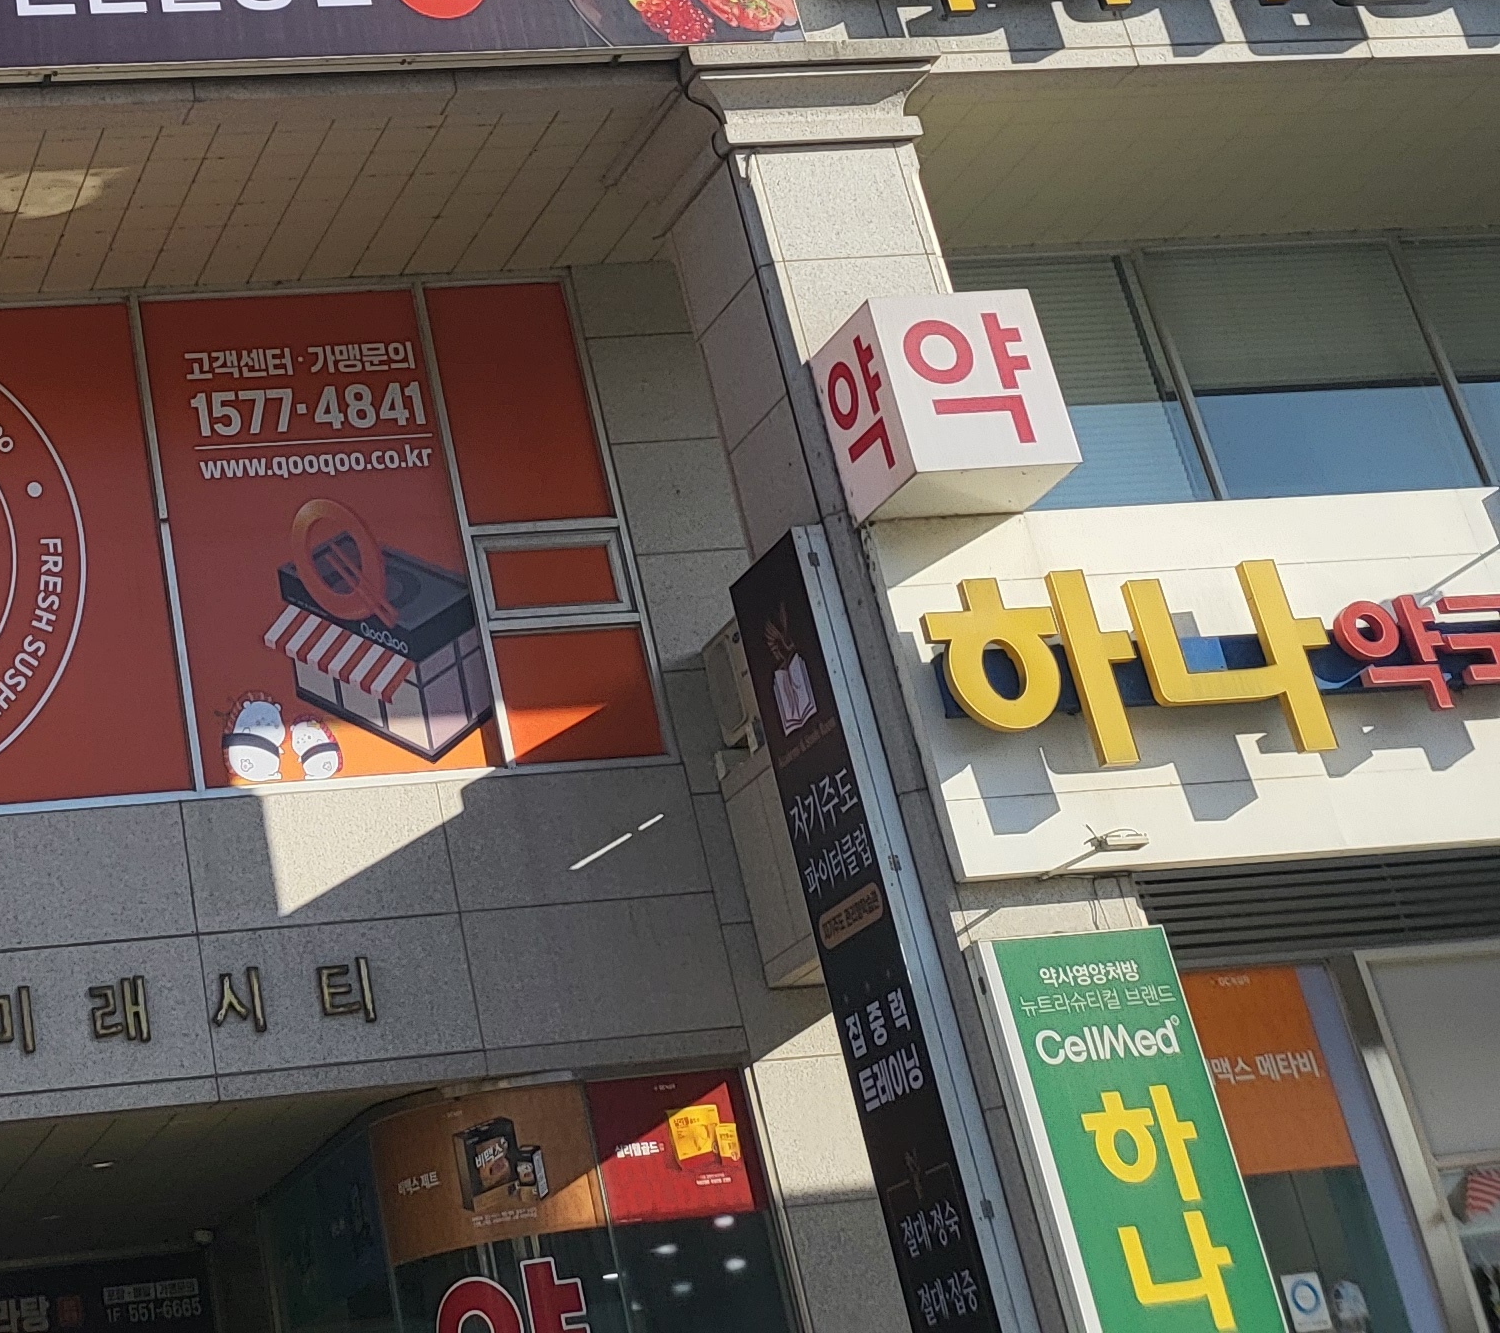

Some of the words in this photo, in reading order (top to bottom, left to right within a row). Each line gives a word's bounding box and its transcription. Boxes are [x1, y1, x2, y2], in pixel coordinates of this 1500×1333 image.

[826, 334, 898, 471] 약
[902, 312, 1038, 444] 약
[198, 444, 434, 480] www.qooqoo.co.kr
[30, 536, 64, 634] FRESH
[920, 558, 1341, 767] 하나
[788, 766, 859, 846] 자기주도
[803, 822, 874, 900] 파이터클럽
[1019, 988, 1122, 1018] 뉴트라슈티컬
[1126, 983, 1177, 1008] 브랜드
[1039, 959, 1139, 987] 약사영양처방
[858, 1043, 925, 1113] 트레이닝
[1035, 1018, 1182, 1066] CellMed
[1255, 1049, 1321, 1083] 메타비
